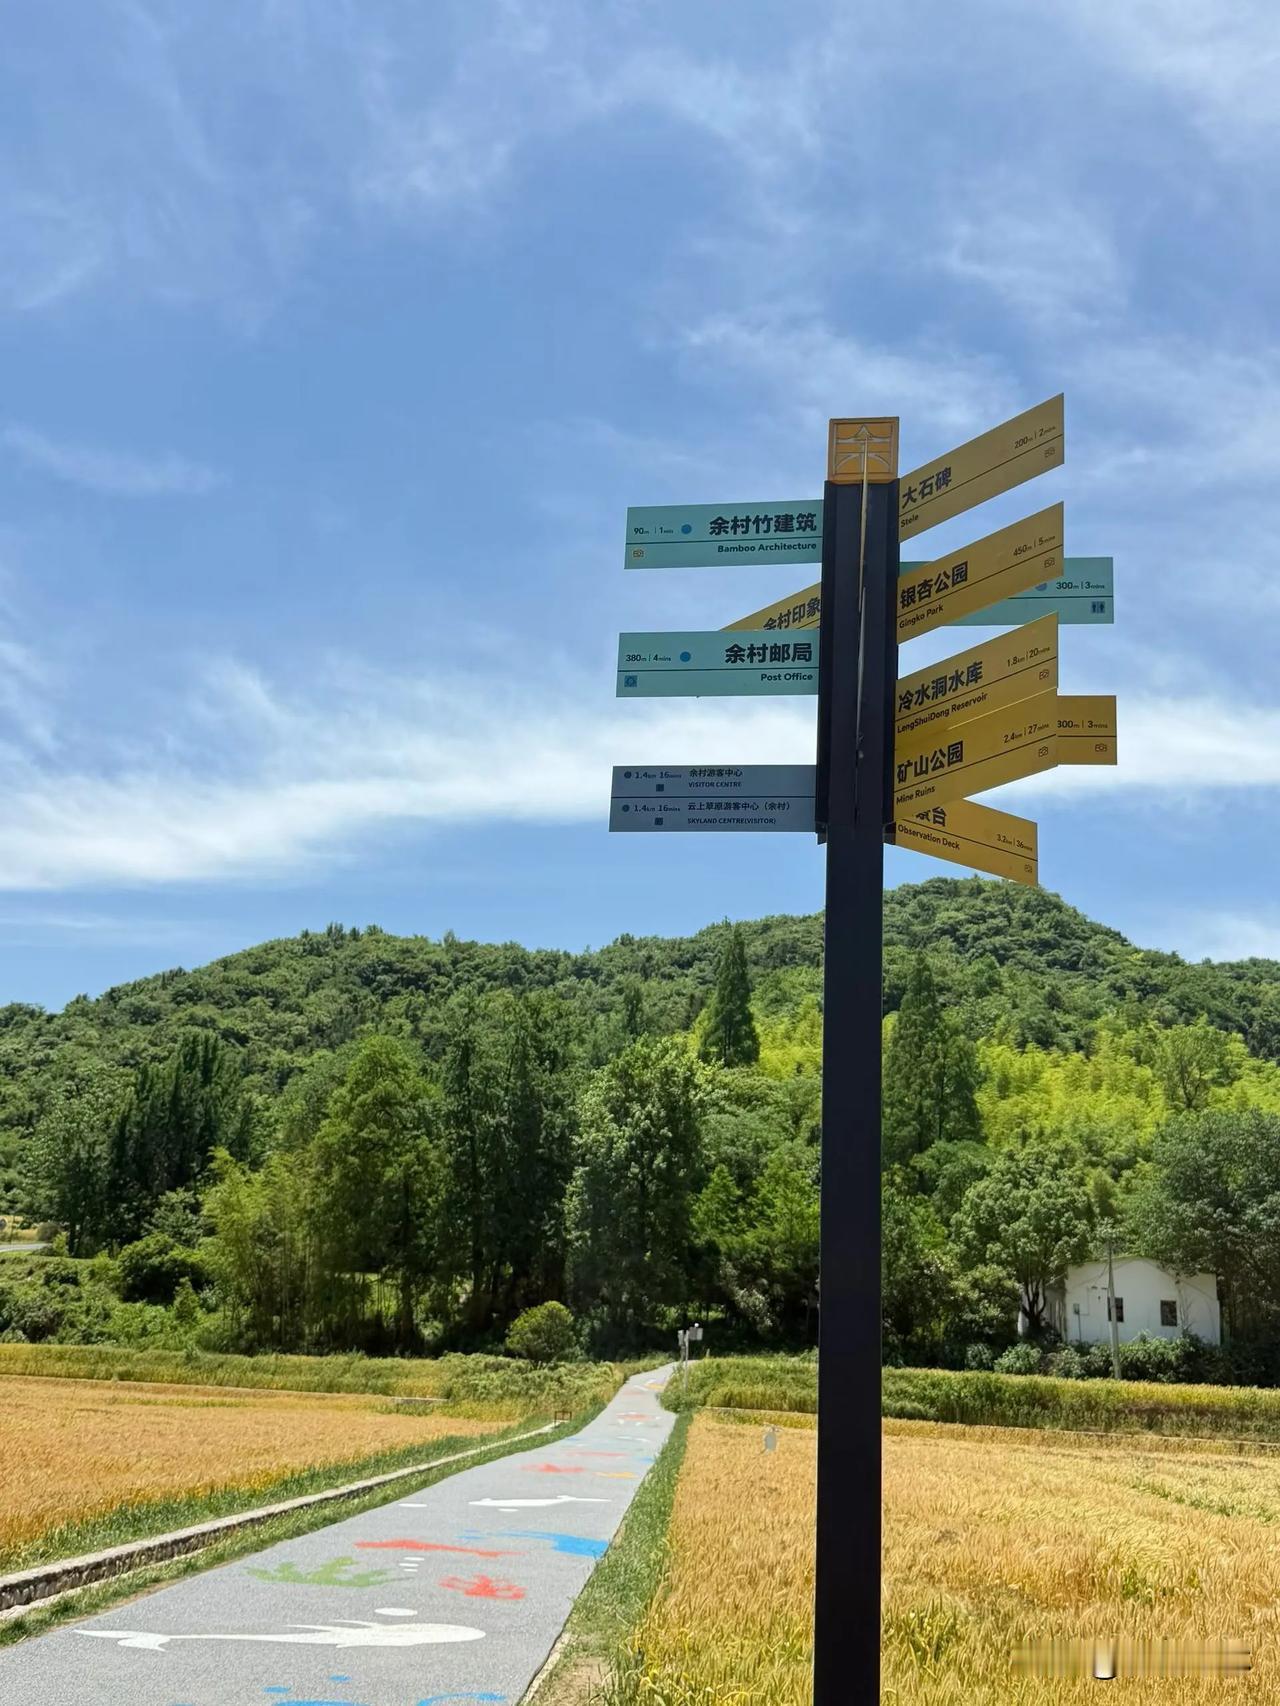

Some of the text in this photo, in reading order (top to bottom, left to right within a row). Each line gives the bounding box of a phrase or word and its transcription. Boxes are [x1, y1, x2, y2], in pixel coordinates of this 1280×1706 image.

[902, 466, 952, 509] 大石碑
[709, 512, 817, 536] 余村竹建筑
[901, 514, 919, 528] Stele
[717, 542, 817, 553] Bamboo Architecture
[900, 560, 968, 610] 银杏公园
[1056, 581, 1105, 590] 300m 3mins
[763, 597, 820, 630] 余村印象
[899, 604, 944, 629] Gingko Park
[625, 653, 672, 662] 380m 4mins
[724, 643, 812, 664] 余村邮局
[760, 672, 813, 681] Post Office
[898, 661, 983, 712] 冷水洞水库
[897, 692, 988, 733] LengShuiDong Reservoir
[1027, 723, 1049, 735] 27mins
[1087, 720, 1108, 729] 3mins
[897, 741, 963, 784] 矿山公园
[690, 768, 743, 778] 余村游客中心
[896, 785, 936, 805] Mine Ruins
[634, 804, 656, 812] 1.4km
[898, 824, 960, 850] Observation Deck
